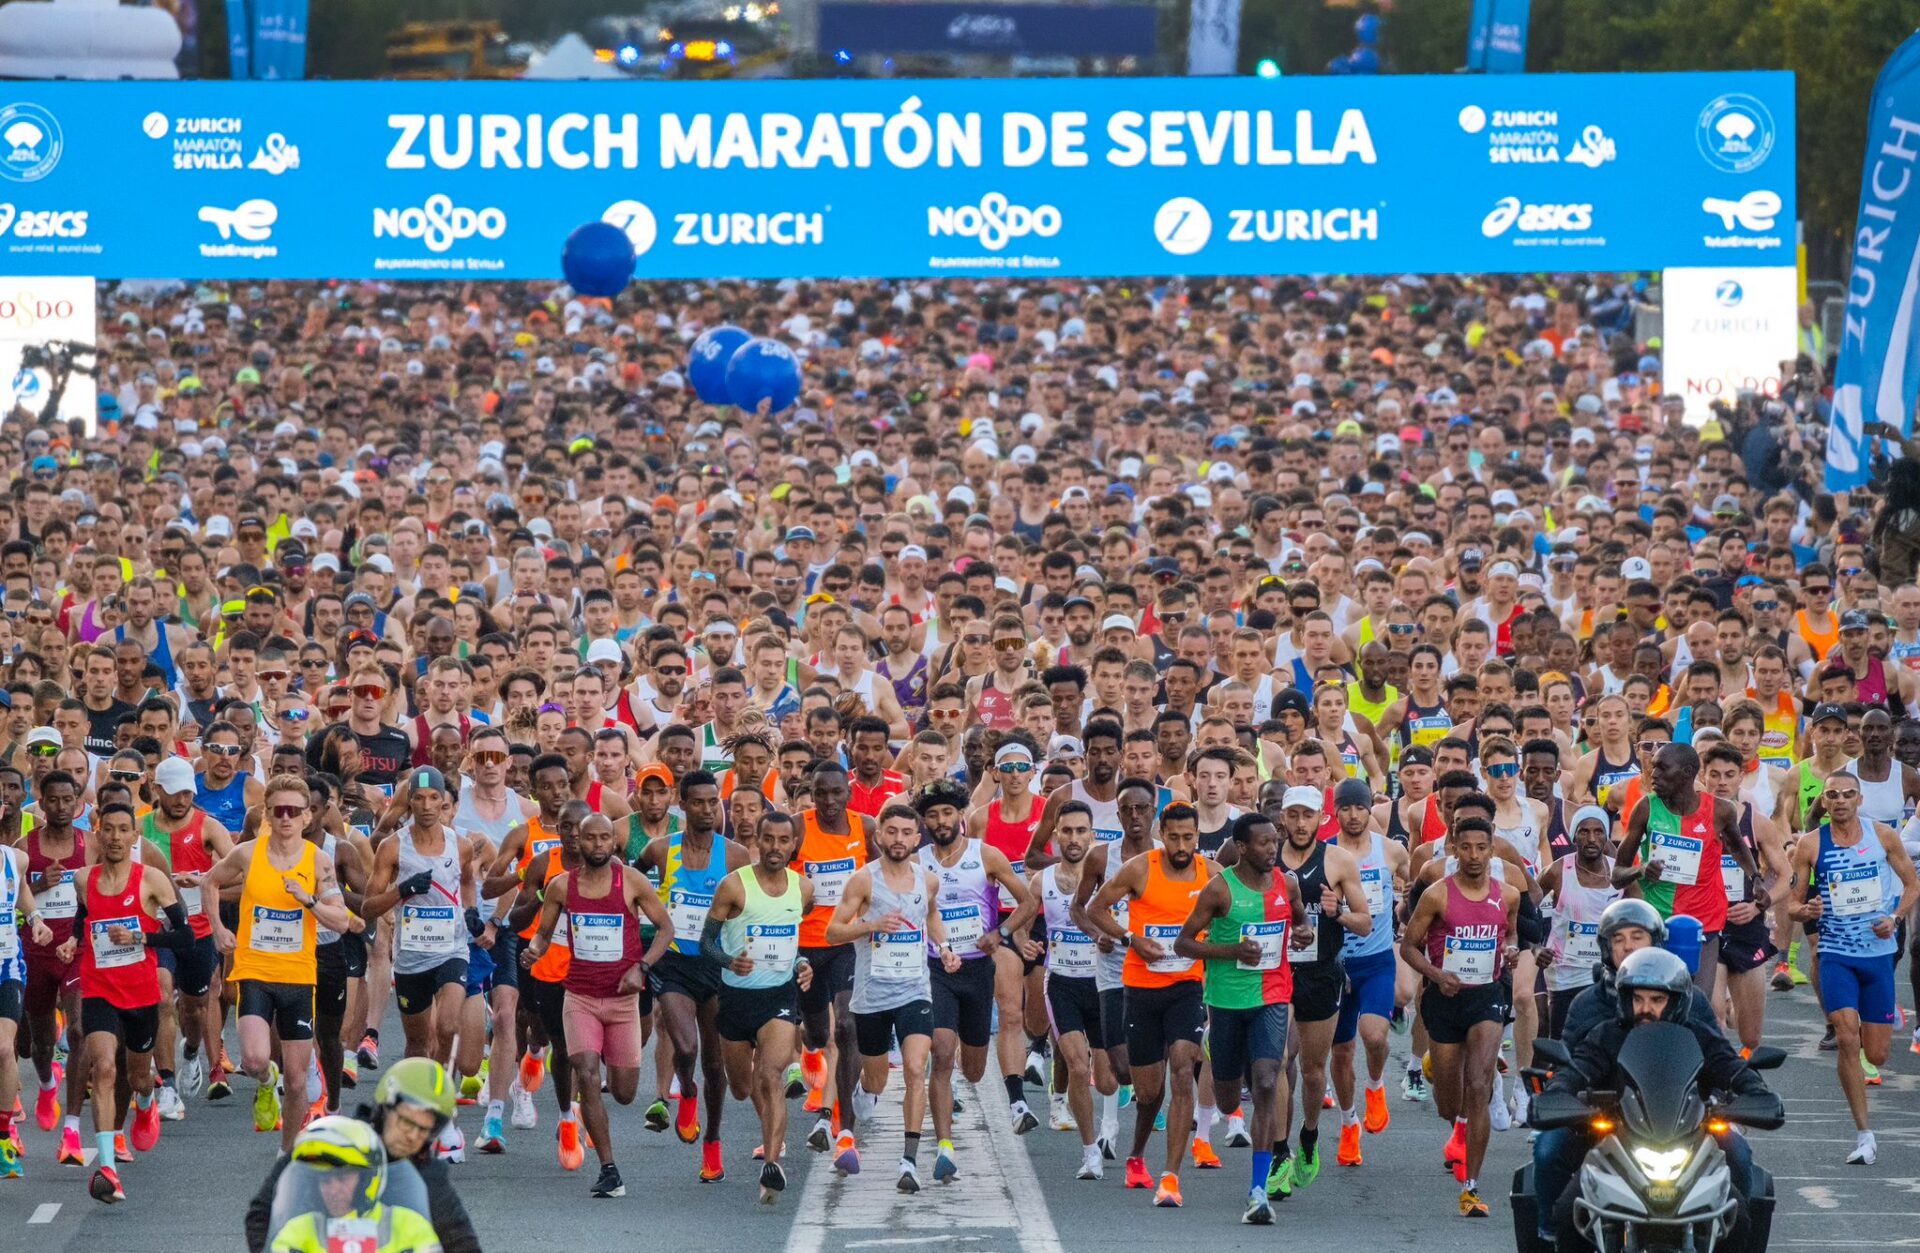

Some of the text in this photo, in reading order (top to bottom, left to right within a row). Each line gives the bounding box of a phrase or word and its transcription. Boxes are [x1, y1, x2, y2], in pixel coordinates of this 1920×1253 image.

[175, 117, 242, 134] ZURICH
[1491, 110, 1558, 127] ZURICH
[387, 96, 1376, 169] ZURICH MARATÓN DE SEVILLA
[1490, 131, 1559, 146] MARATÓN
[174, 138, 242, 152] MARATÓN
[173, 153, 243, 169] SEVILLA
[1489, 146, 1560, 164] SEVILLA
[14, 209, 88, 238] asics
[1517, 203, 1592, 231] asics
[674, 212, 823, 245] ZURICH
[1228, 209, 1378, 241] ZURICH
[1845, 115, 1920, 355] ZURICH
[1703, 235, 1781, 250] TotalEnergies
[199, 244, 278, 259] TotalEnergies
[1691, 317, 1769, 333] ZURICH
[84, 736, 117, 749] limc
[1668, 838, 1696, 849] ZURICH
[1668, 854, 1678, 862] 38
[821, 862, 849, 871] ZURICH
[1845, 872, 1873, 880] ZURICH
[1851, 887, 1860, 895] 26
[270, 911, 298, 920] ZURICH
[588, 917, 617, 926] ZURICH
[945, 910, 973, 919] ZURICH
[423, 925, 432, 933] 60
[765, 926, 791, 935] ZURICH
[1259, 925, 1282, 933] ZURICH
[1455, 924, 1499, 939] POLIZIA
[892, 932, 918, 941] ZURICH
[768, 943, 776, 951] 11
[1466, 956, 1475, 964] 43
